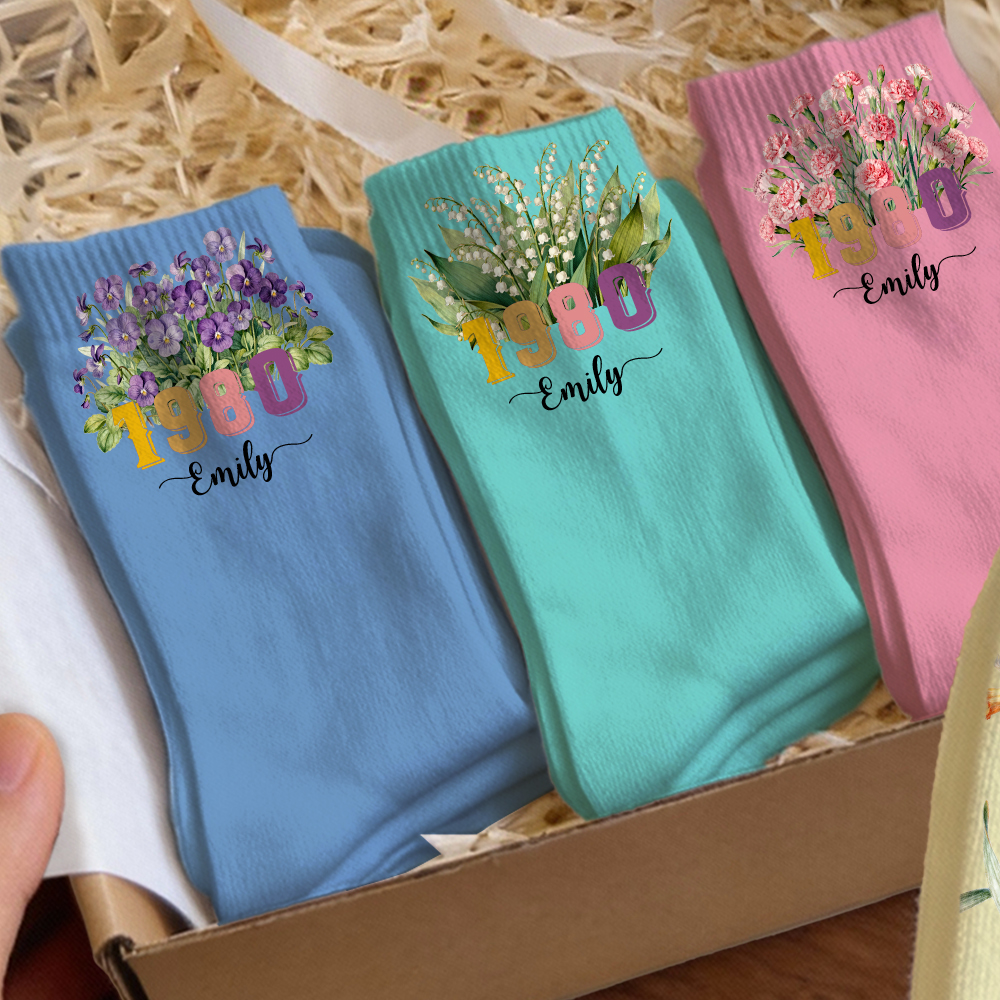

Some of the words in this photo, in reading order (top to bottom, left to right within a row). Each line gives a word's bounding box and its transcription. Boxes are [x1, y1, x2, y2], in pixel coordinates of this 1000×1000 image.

[788, 167, 972, 280] 1980
[833, 246, 976, 304] Emily
[461, 262, 657, 385] 1980
[111, 347, 308, 470] 1980
[508, 347, 663, 411] Emily
[158, 433, 313, 496] Emily
